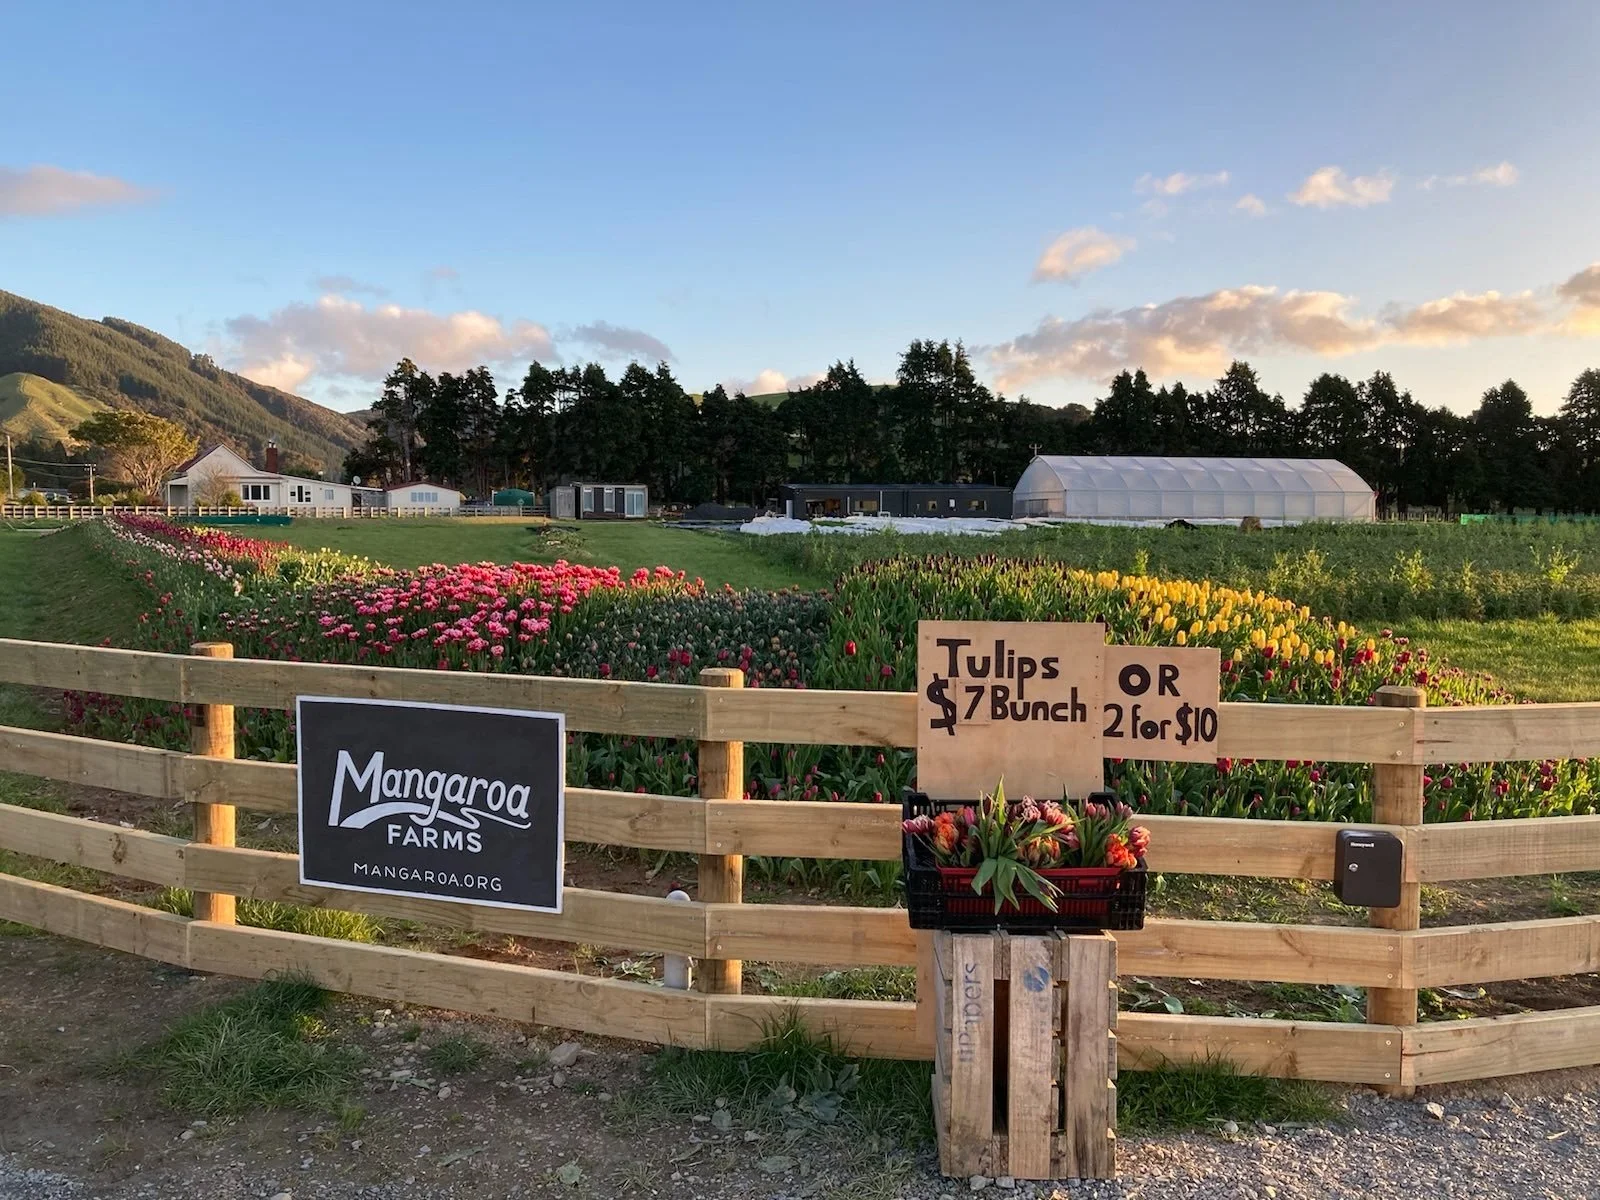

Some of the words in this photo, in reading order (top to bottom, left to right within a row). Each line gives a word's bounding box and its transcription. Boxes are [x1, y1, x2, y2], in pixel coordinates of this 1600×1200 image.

[936, 638, 1059, 700] Tulips
[1118, 664, 1181, 697] OR
[991, 685, 1087, 722] Bunch
[1103, 703, 1124, 738] 2
[1131, 704, 1171, 740] for
[1175, 702, 1218, 746] $10
[328, 750, 532, 829] Mangaroa
[388, 824, 483, 853] FARMS
[353, 862, 502, 892] MANGAROA.ORG
